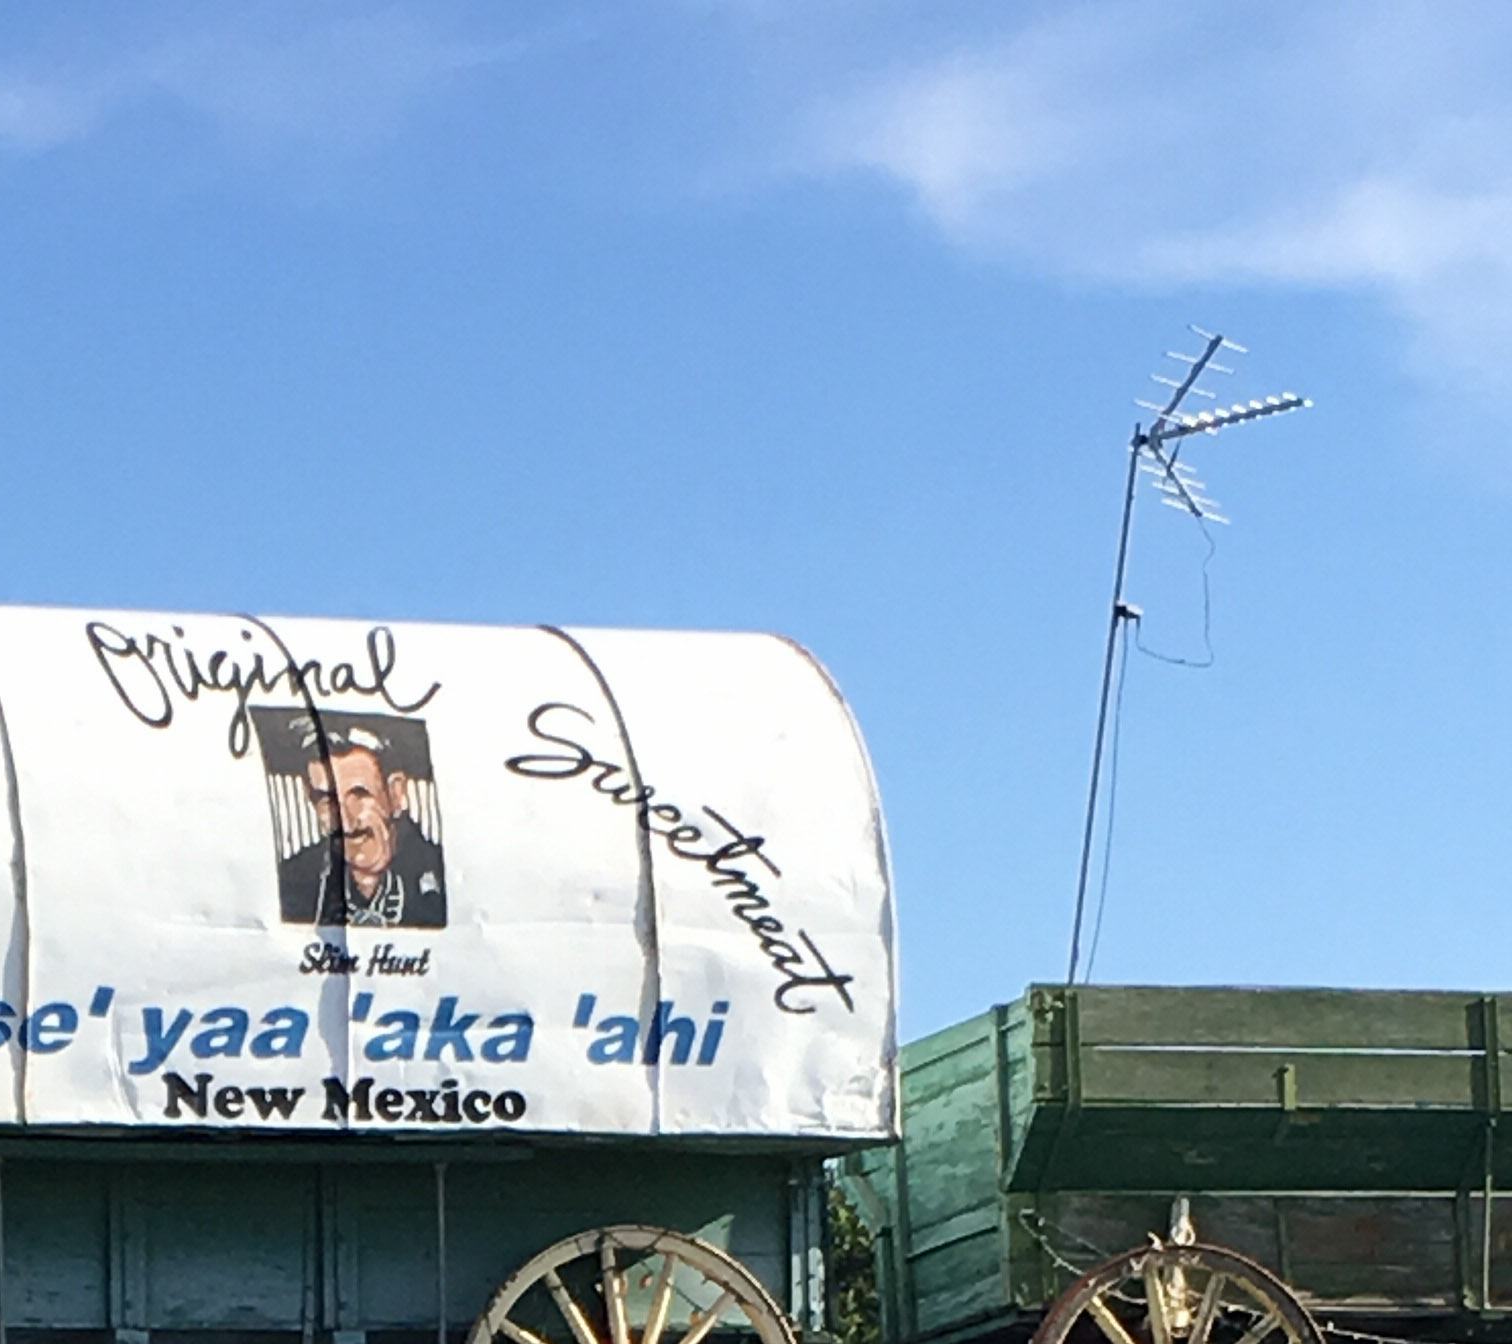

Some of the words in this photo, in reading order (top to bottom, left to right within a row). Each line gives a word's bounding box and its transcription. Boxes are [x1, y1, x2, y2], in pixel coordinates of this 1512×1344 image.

[85, 621, 442, 760] Original
[504, 702, 854, 1014] Sweetmeat
[366, 943, 431, 977] Hunt
[128, 1006, 310, 1076] yaa
[349, 992, 535, 1063] 'aka
[573, 993, 729, 1067] 'ahi
[162, 1071, 306, 1121] New
[321, 1077, 527, 1123] Mexico
